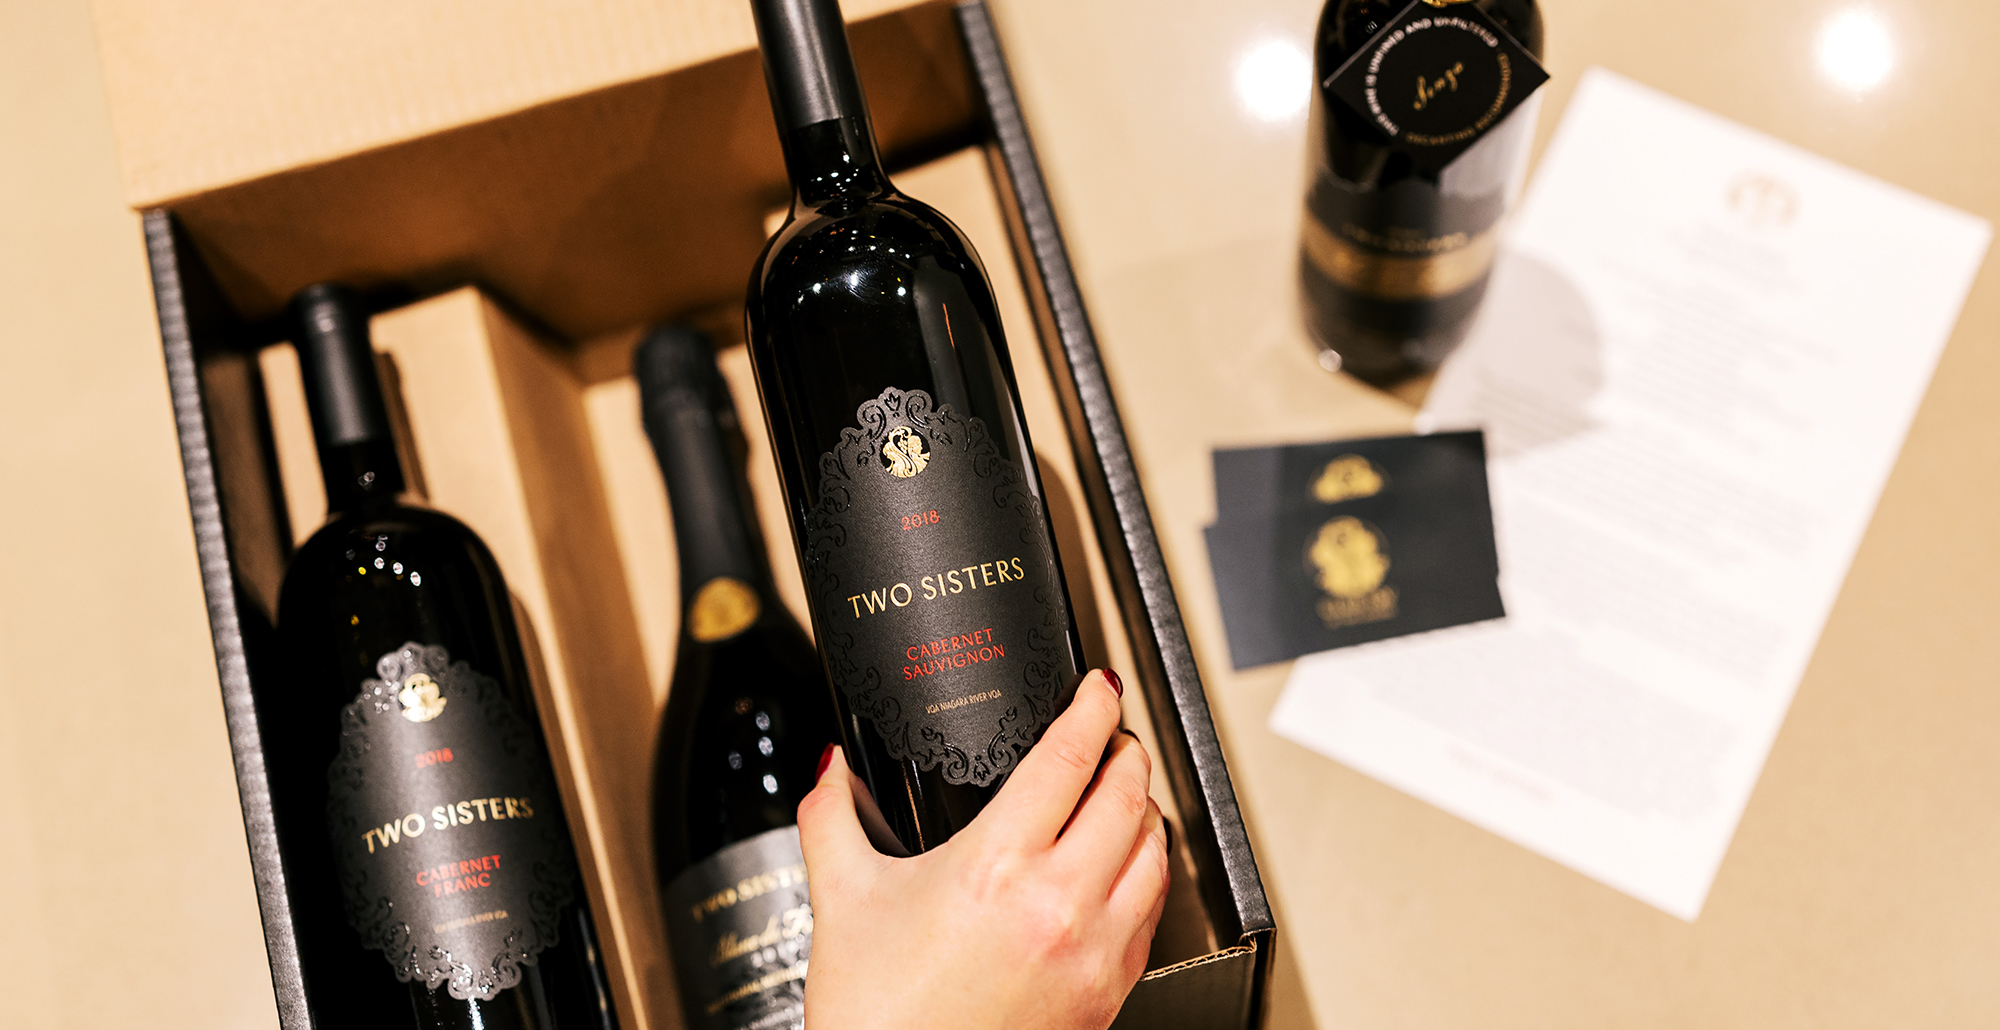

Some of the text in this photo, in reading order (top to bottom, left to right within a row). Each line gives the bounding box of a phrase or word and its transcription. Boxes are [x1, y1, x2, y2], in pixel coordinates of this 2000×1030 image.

[1405, 17, 1432, 35] AND
[1433, 16, 1498, 48] UNFILTERED
[901, 509, 940, 531] 2018
[847, 556, 1025, 619] TWO SISTERS
[906, 627, 993, 661] CABERNET
[903, 643, 1005, 681] SAUVIGNON
[925, 689, 1002, 715] VQA NIAGARA RIVER VQA
[415, 747, 454, 769] 2018
[361, 796, 535, 855] TWO SISTERS
[416, 854, 502, 887] CABERNET
[433, 872, 492, 898] FRANC
